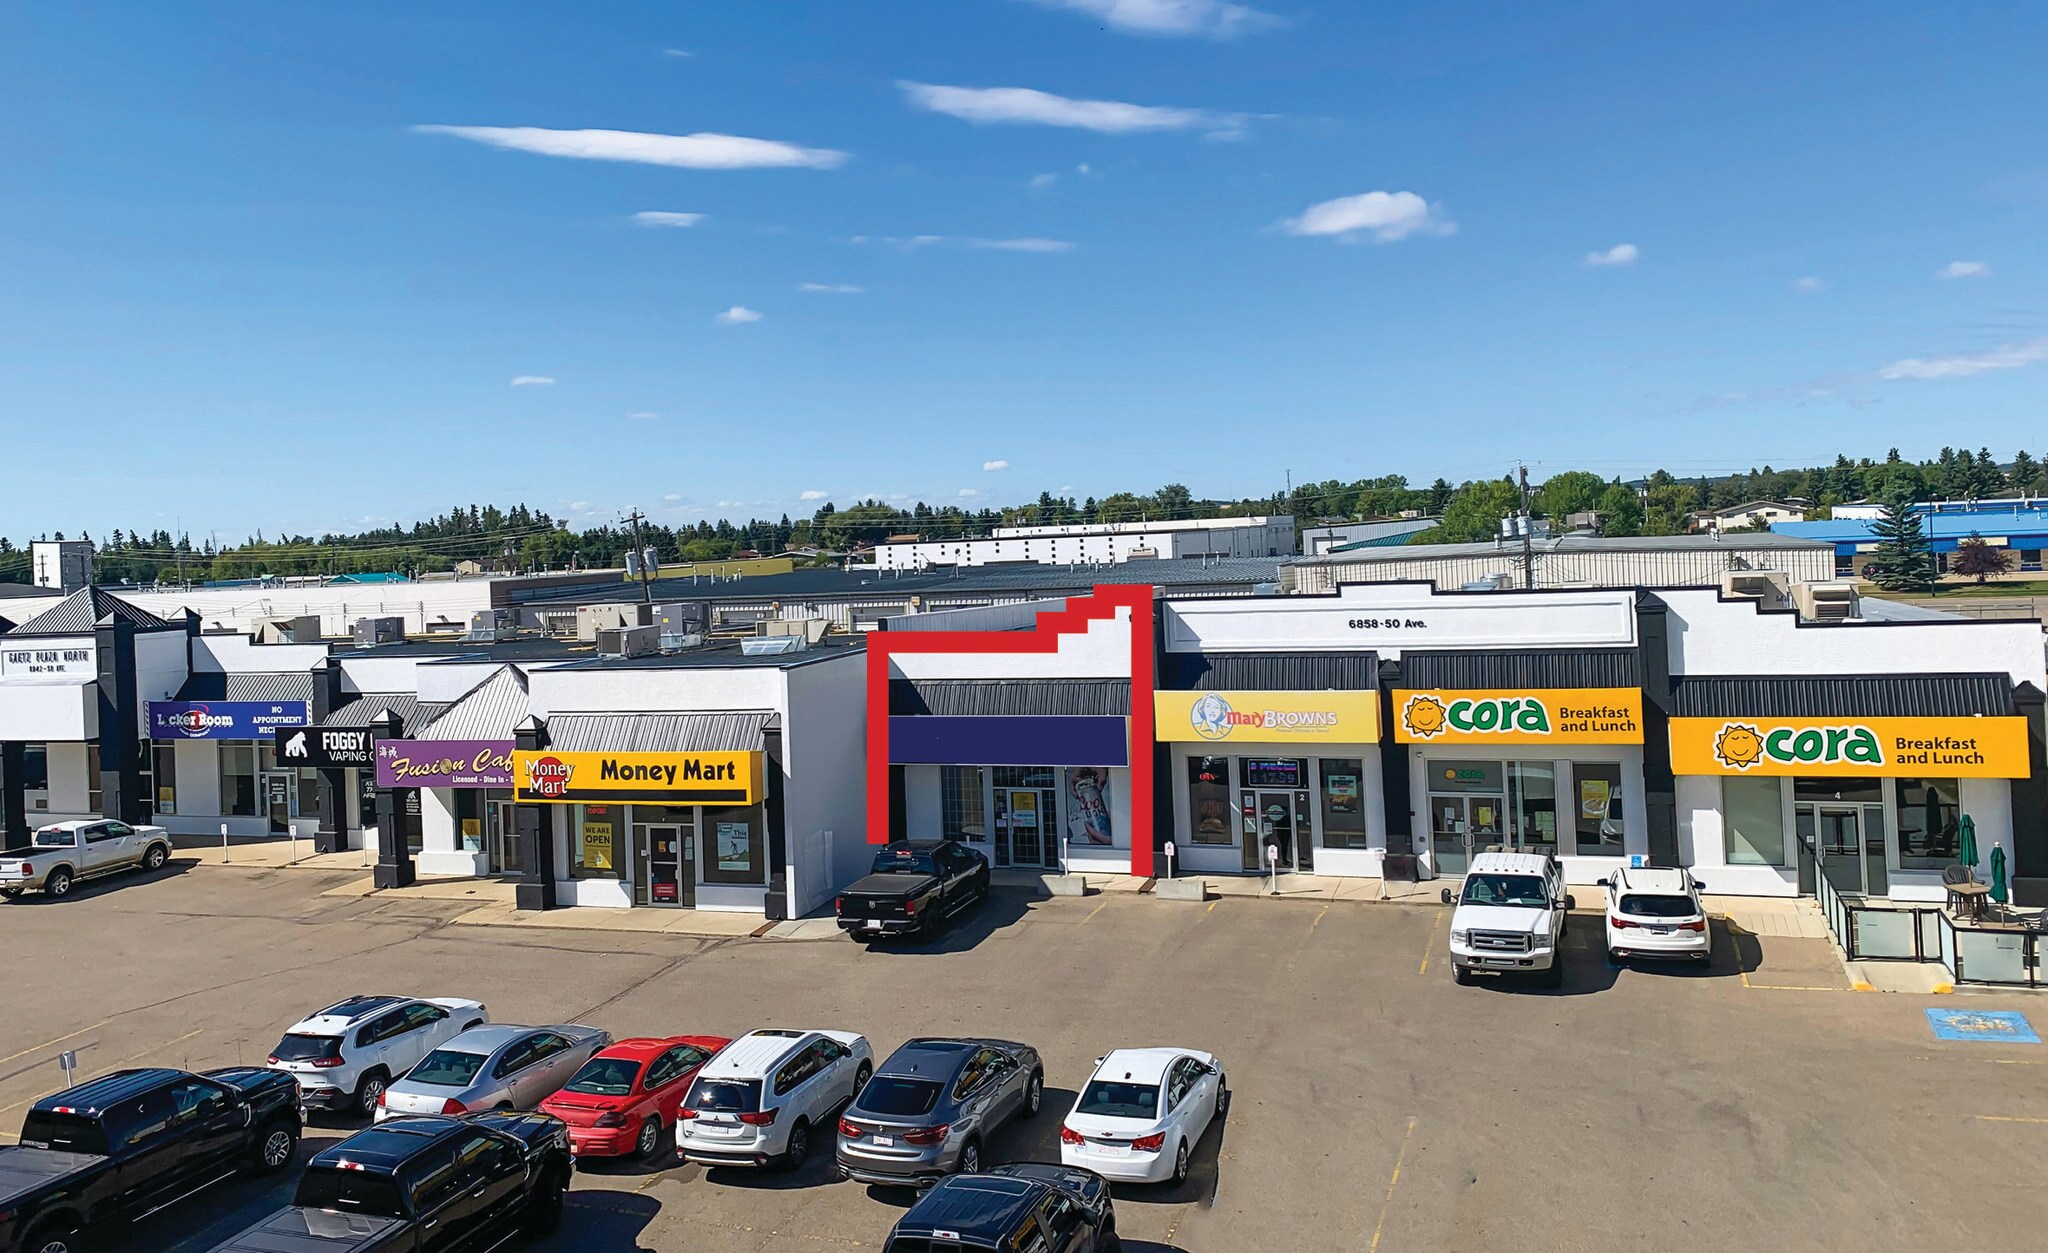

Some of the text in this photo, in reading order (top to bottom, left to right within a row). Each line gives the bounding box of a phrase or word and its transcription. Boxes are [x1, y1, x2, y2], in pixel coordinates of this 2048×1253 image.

[1348, 618, 1428, 629] 6858-50 Ave.
[8, 650, 89, 663] GAETZ PLAZA NORTH
[271, 706, 283, 714] NO
[1448, 699, 1550, 731] cora
[1559, 707, 1630, 718] Breakfast
[198, 713, 234, 726] Room
[252, 716, 302, 724] APPOINTMENT
[1560, 720, 1637, 732] and Lunch
[322, 732, 366, 750] FOGGY
[1765, 728, 1881, 764] cora
[1895, 737, 1977, 750] Breakfast
[328, 751, 367, 762] VAPING
[1896, 751, 1985, 764] and Lunch
[390, 756, 466, 782] Fusion
[524, 758, 575, 782] Money
[600, 759, 736, 785] Money Mart
[452, 775, 478, 783] Licensed
[529, 777, 568, 794] Mart
[1299, 793, 1305, 801] 2
[1834, 791, 1841, 800] 4
[584, 826, 610, 834] WE ARE
[584, 835, 610, 844] OPEN
